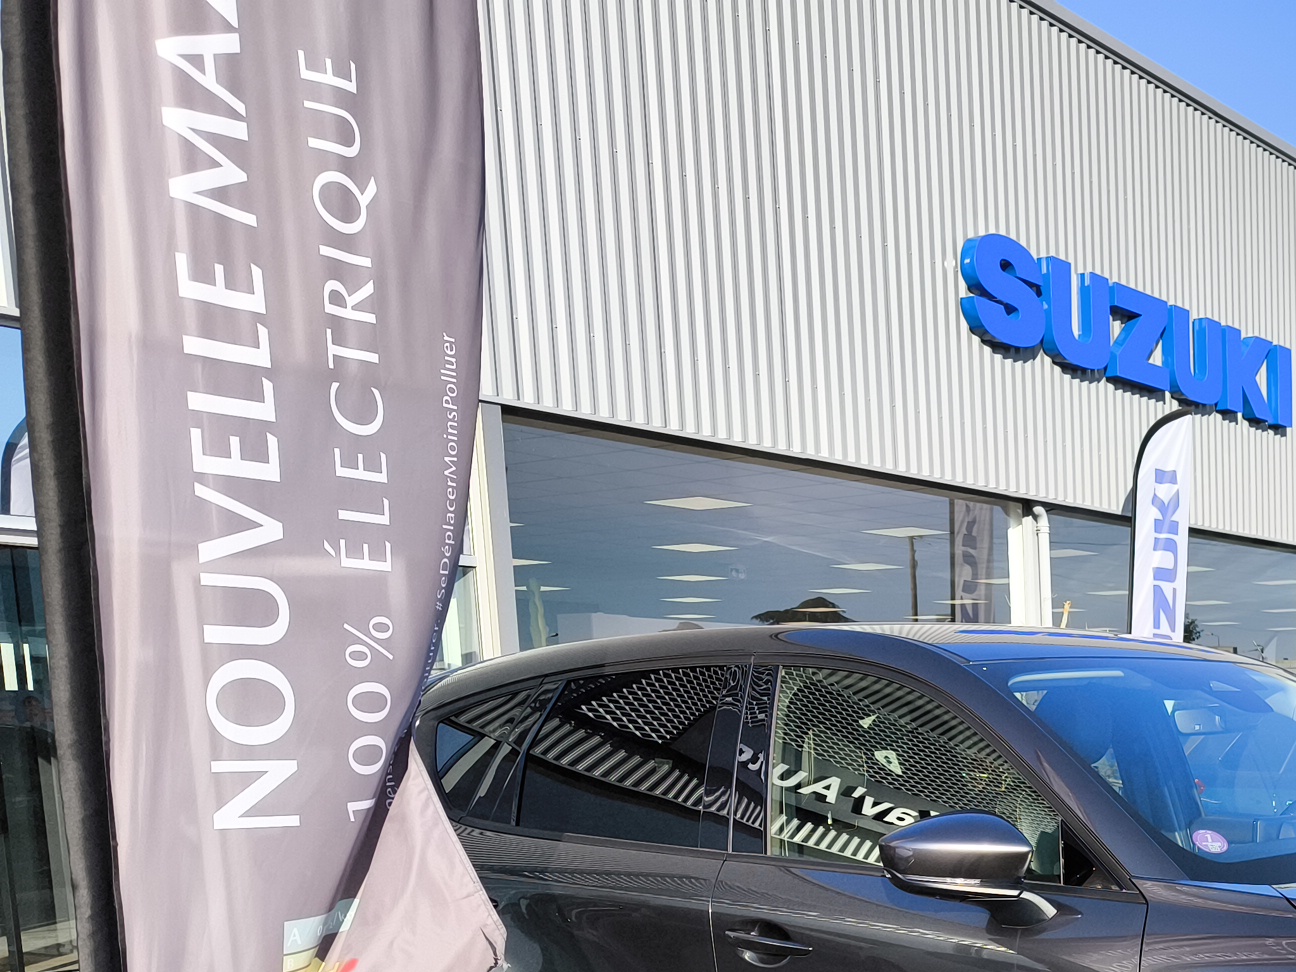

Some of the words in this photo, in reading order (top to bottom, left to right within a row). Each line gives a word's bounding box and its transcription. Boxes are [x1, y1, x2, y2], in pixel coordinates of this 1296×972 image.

[297, 48, 393, 574] ÉLECTRIQUE
[960, 233, 1293, 428] SUZUKI
[175, 252, 301, 831] NOUVELLE
[435, 332, 459, 612] #SeDéplacerMoinsPolluer
[287, 927, 302, 947] A
